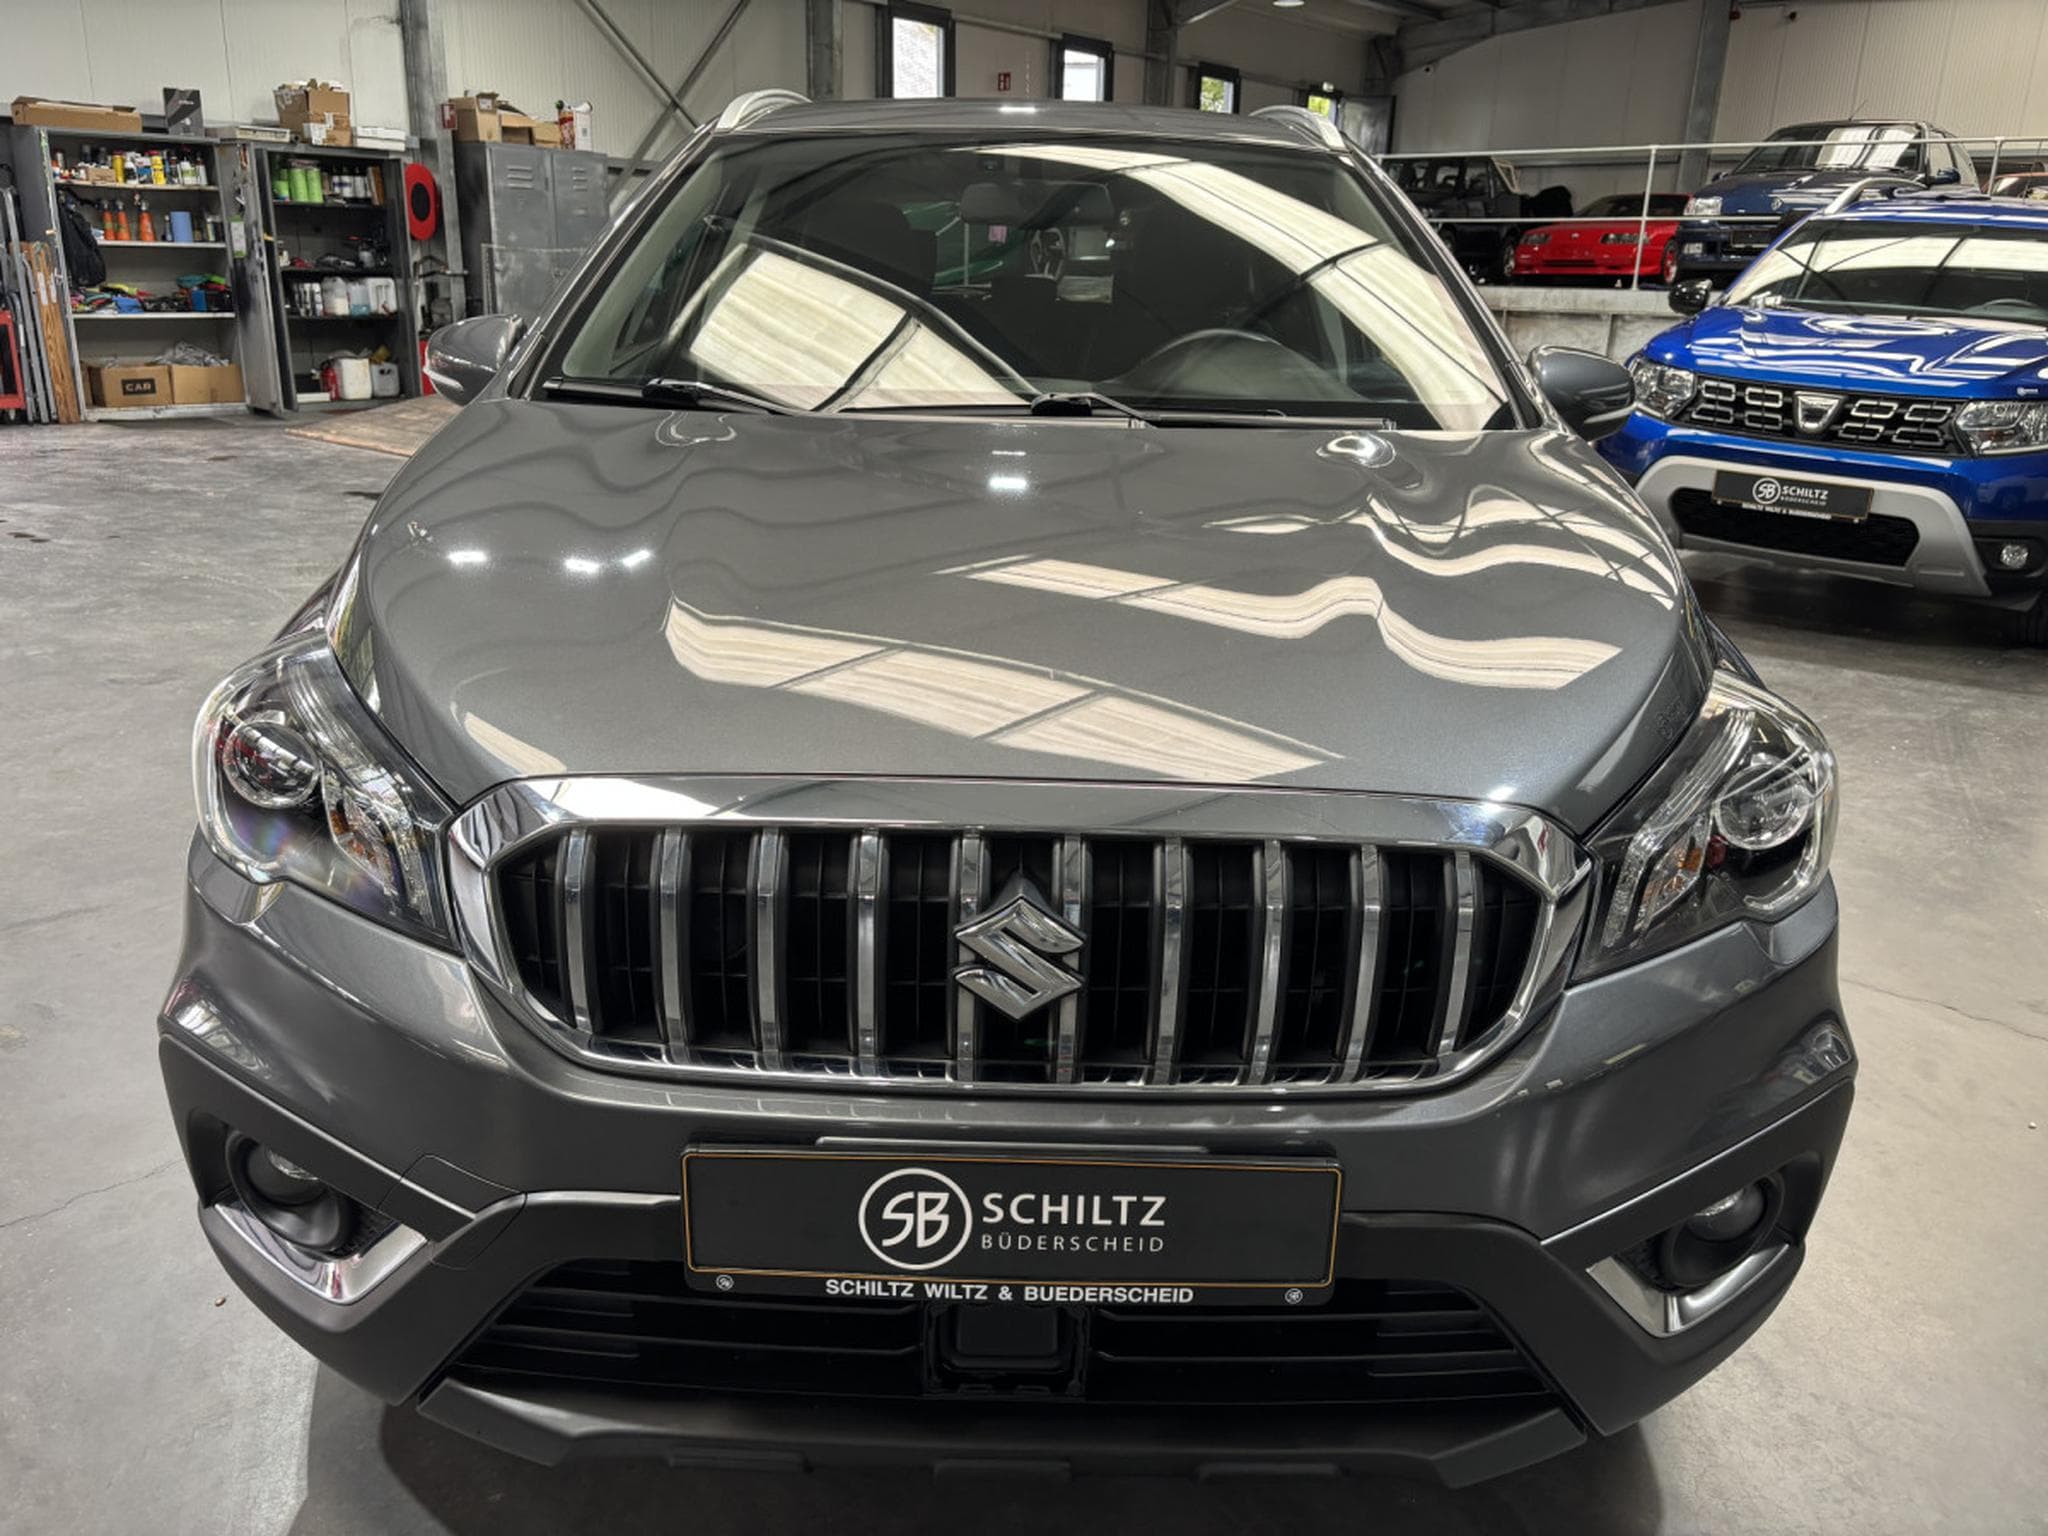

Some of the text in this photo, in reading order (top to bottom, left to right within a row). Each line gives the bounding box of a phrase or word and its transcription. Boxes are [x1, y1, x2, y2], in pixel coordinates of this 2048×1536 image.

[1781, 485, 1829, 500] SCHILTZ
[881, 1190, 950, 1249] SB
[981, 1192, 1168, 1227] SCHILTZ
[980, 1231, 1165, 1253] BÜDERSCHEID
[825, 1278, 1194, 1304] SCHILTZ WILTZ & BUEDERSCHEID
